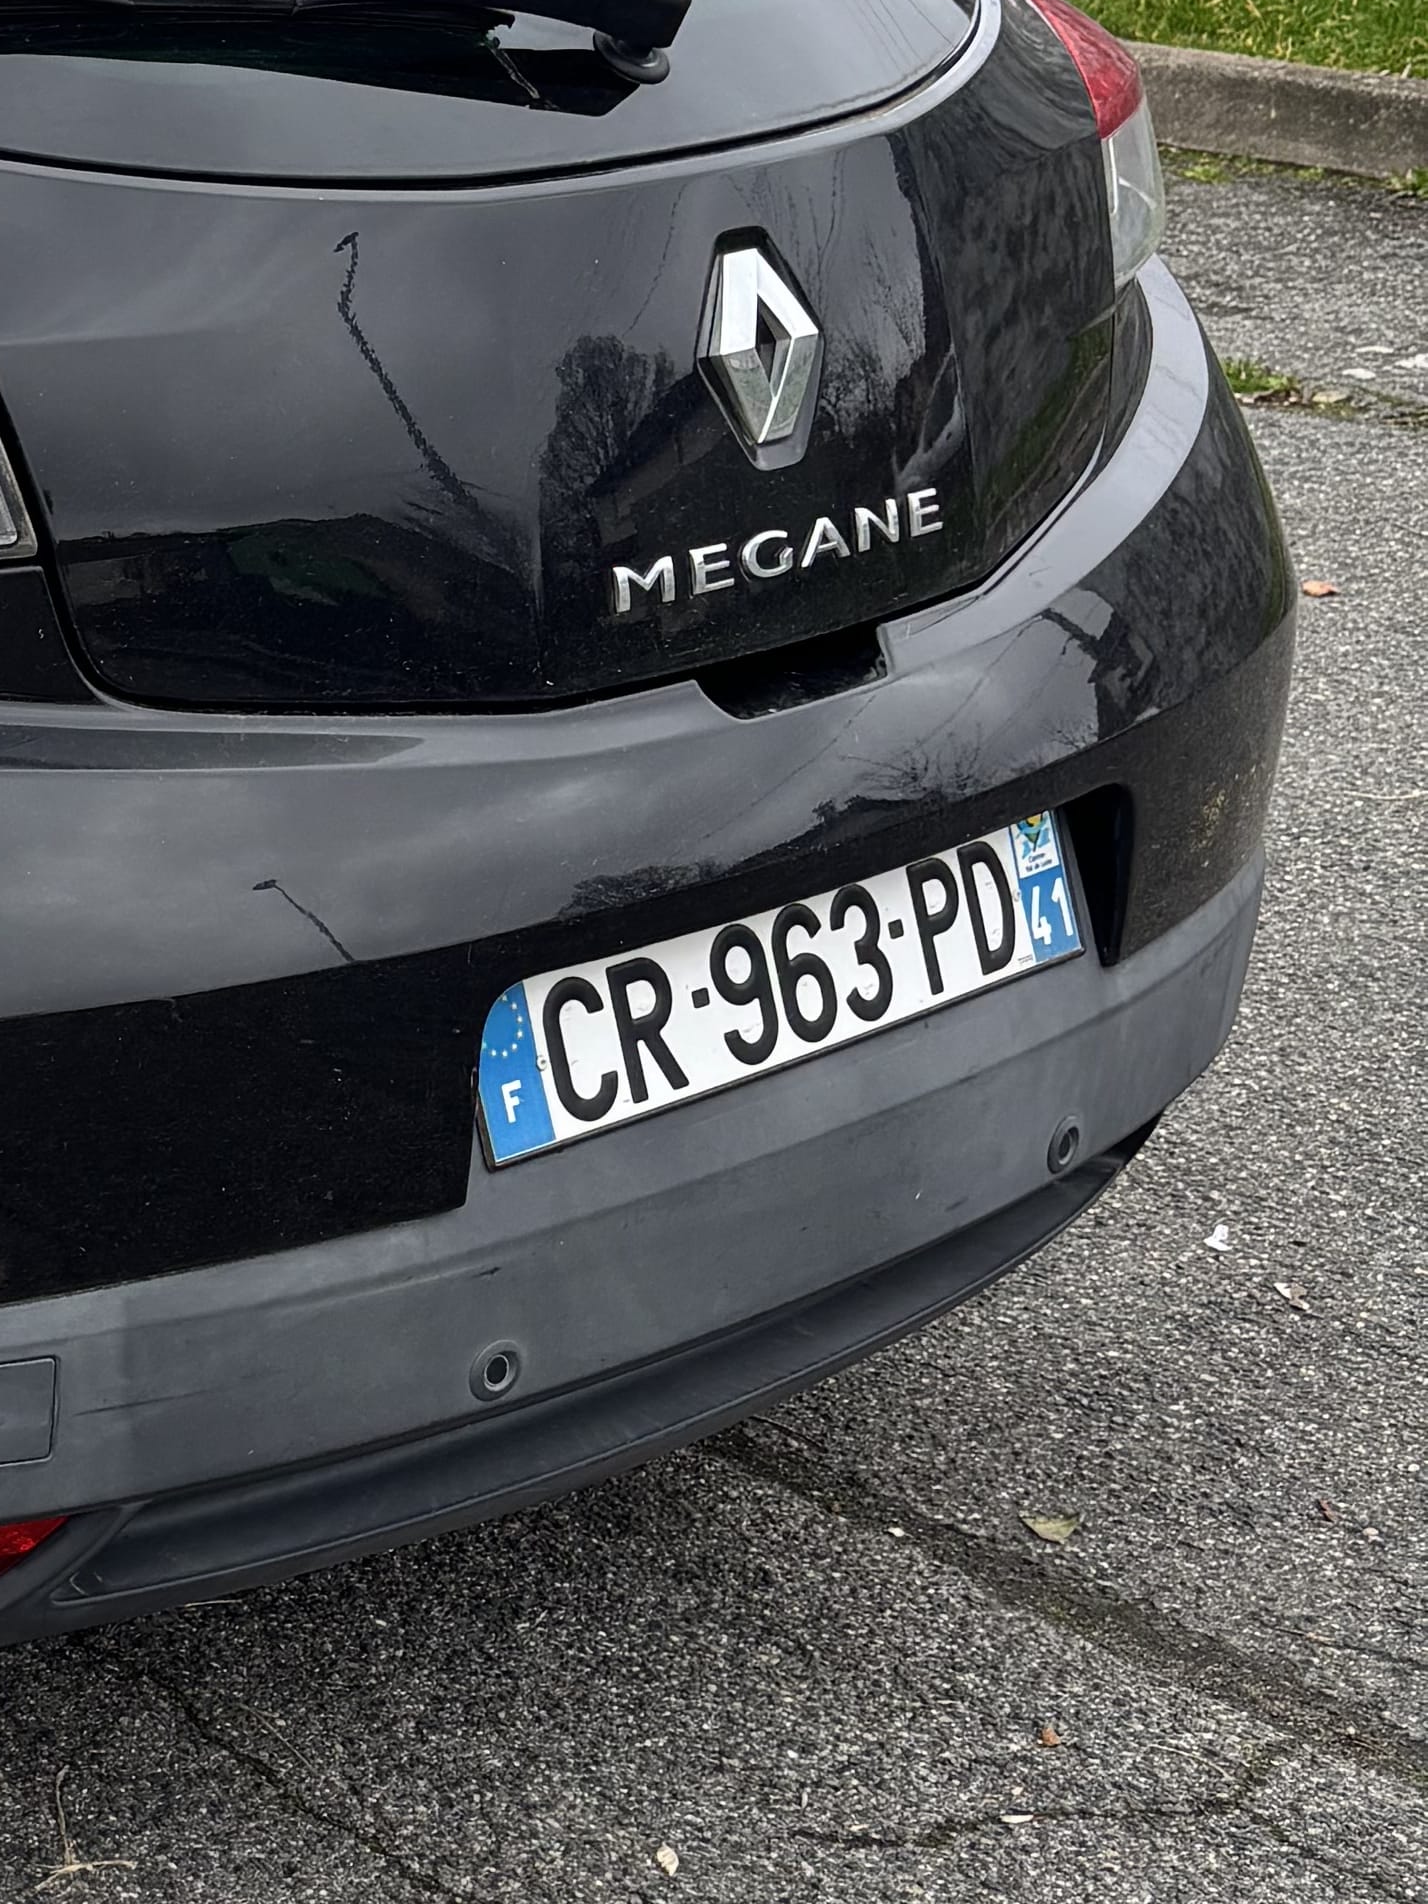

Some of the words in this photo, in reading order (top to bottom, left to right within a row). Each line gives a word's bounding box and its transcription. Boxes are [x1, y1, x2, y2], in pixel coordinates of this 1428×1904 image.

[611, 487, 944, 614] MEGANE
[501, 1078, 523, 1124] F
[542, 840, 1017, 1123] CR-963-PD
[1030, 876, 1074, 945] 41
